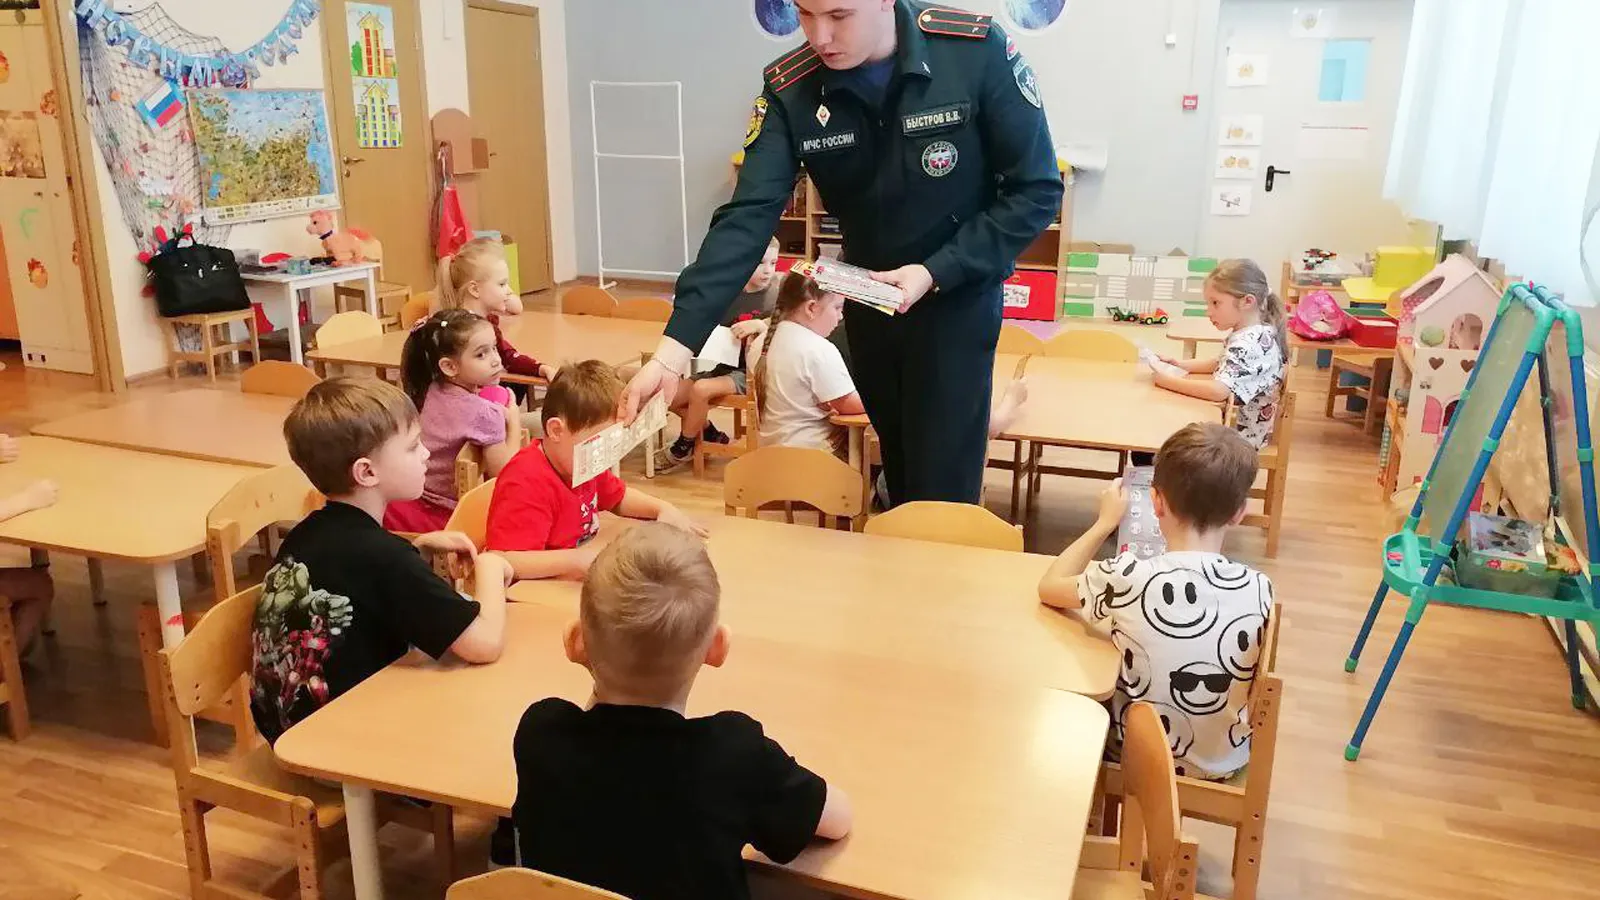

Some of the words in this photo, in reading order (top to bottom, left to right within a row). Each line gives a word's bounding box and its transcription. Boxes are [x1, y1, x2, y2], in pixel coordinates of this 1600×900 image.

[905, 114, 944, 129] БЫСТРОВ
[945, 110, 961, 123] В.В.
[803, 138, 821, 151] МЧС
[822, 133, 855, 149] РОССИИ
